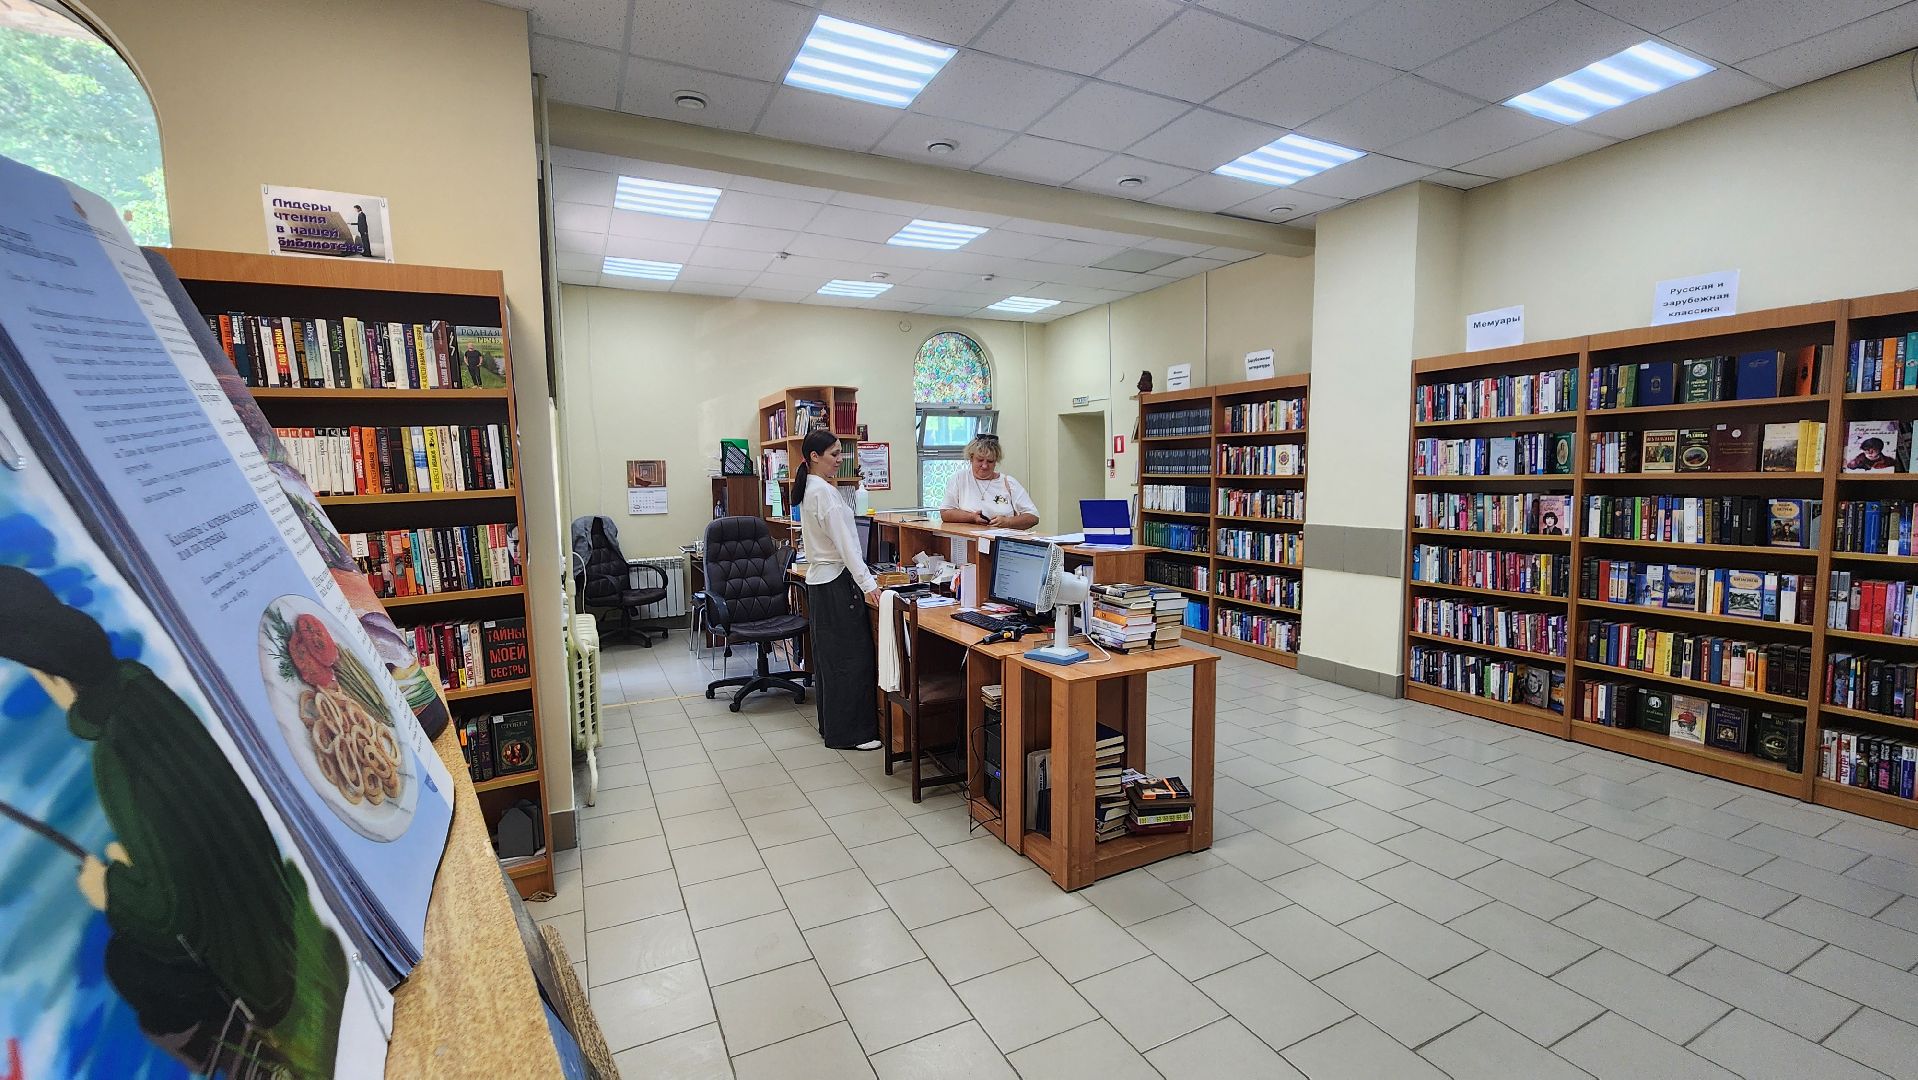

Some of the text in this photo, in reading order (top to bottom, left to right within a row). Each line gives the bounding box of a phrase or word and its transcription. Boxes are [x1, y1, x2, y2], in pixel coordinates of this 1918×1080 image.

[272, 198, 332, 212] Лидеры
[274, 212, 327, 224] чтения
[276, 225, 340, 239] в нашей
[1669, 282, 1714, 295] Русская
[1662, 292, 1730, 307] зарубежная
[1668, 306, 1720, 317] классика
[1472, 314, 1521, 330] Мемуары
[461, 328, 500, 337] РОДНАЯ
[274, 328, 284, 353] ОБМАНА
[477, 336, 500, 344] РЕЧЬ
[486, 626, 526, 643] ТАЙНЫ
[489, 643, 526, 664] МОЕЙ
[490, 663, 528, 679] СЕСТРЫ
